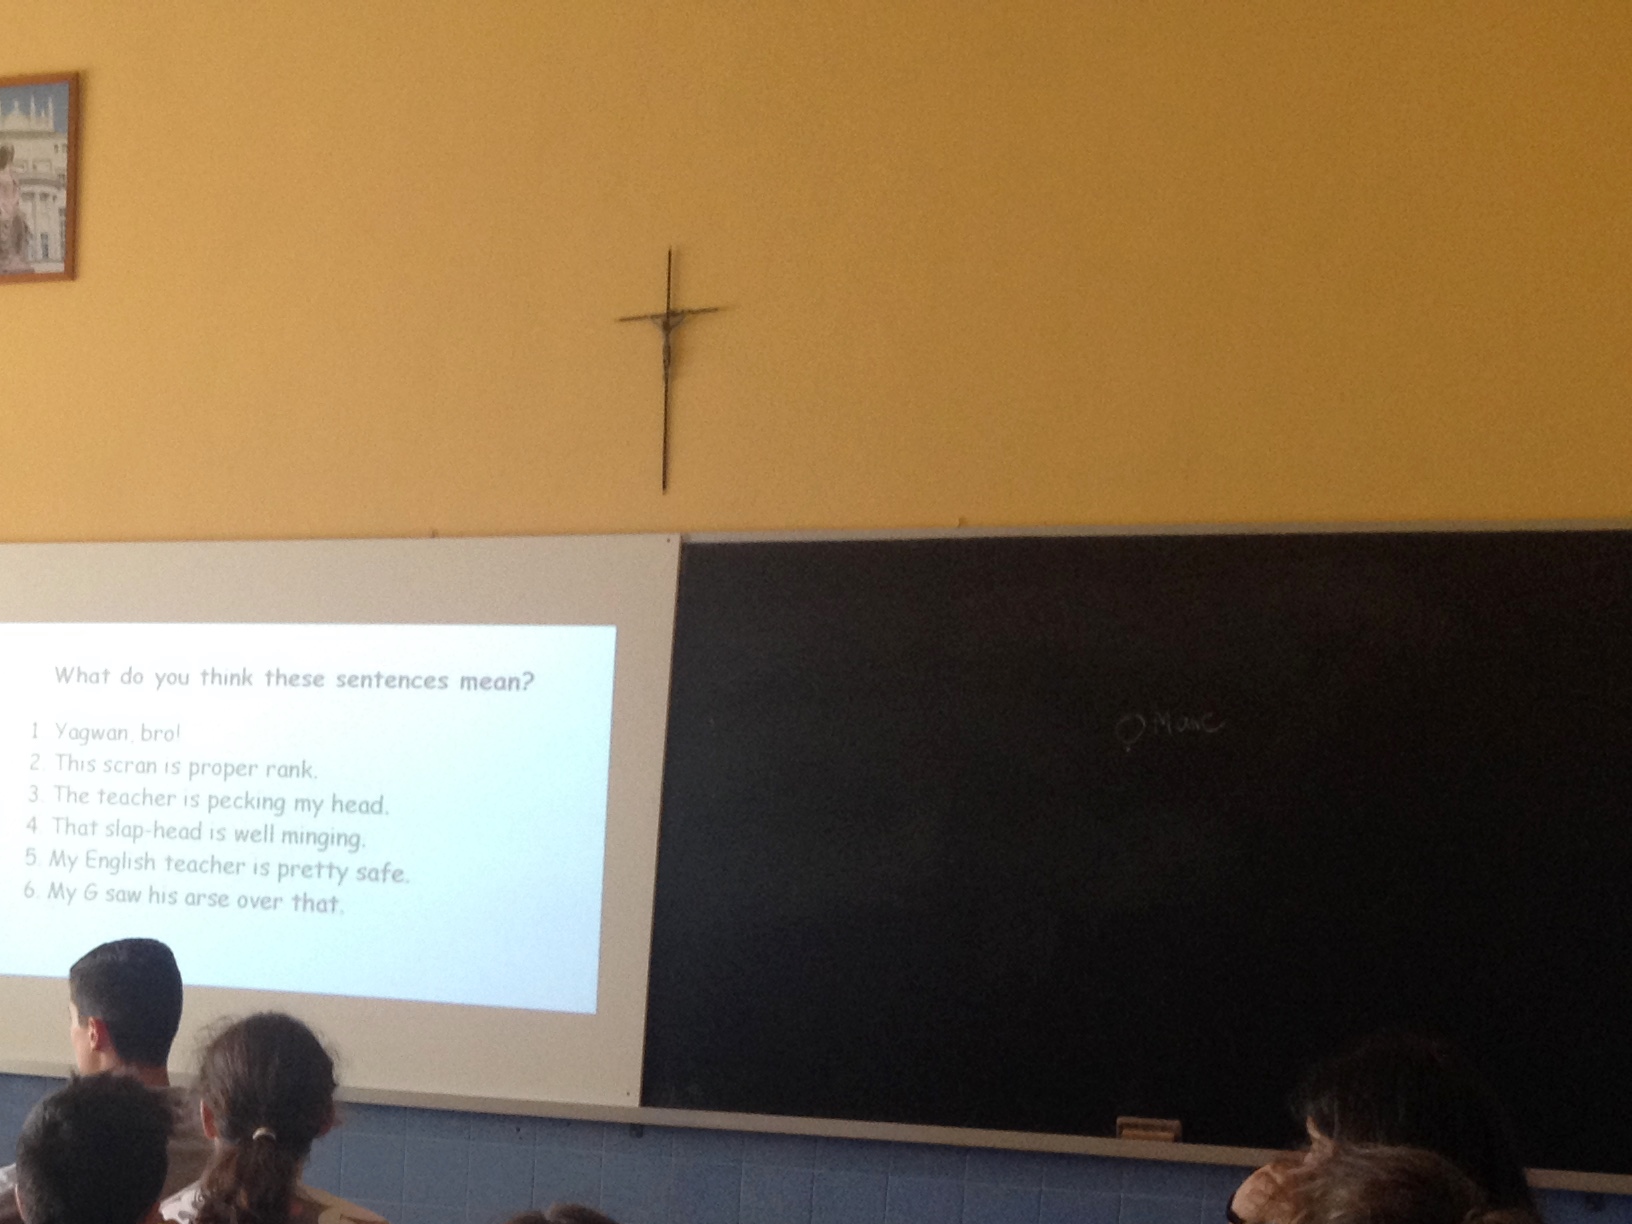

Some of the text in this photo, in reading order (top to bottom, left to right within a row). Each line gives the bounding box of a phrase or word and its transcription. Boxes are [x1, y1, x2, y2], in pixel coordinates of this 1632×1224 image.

[54, 665, 536, 693] What do you think these sentences mean?
[140, 722, 181, 743] bro!
[56, 753, 96, 773] This
[103, 759, 158, 775] scran
[164, 760, 182, 776] is
[188, 760, 259, 783] proper
[265, 758, 318, 780] rank.
[53, 784, 90, 805] The
[97, 786, 177, 808] teacher
[183, 793, 201, 809] is
[207, 790, 287, 818] pecking
[293, 797, 325, 819] my
[330, 792, 390, 816] head.
[52, 816, 99, 837] That
[105, 818, 203, 845] slap-head
[209, 826, 227, 843] is
[233, 823, 275, 844] well
[280, 829, 366, 855] minging.
[48, 848, 79, 873] My
[85, 848, 156, 876] English
[164, 853, 247, 876] teacher
[252, 861, 271, 878] is
[276, 860, 350, 887] pretty
[355, 860, 410, 884] safe.
[46, 881, 78, 907] My
[83, 882, 99, 902] G
[105, 887, 143, 904] saw
[147, 884, 179, 906] his
[183, 891, 230, 909] arse
[236, 894, 284, 912] over
[291, 891, 345, 915] that.
